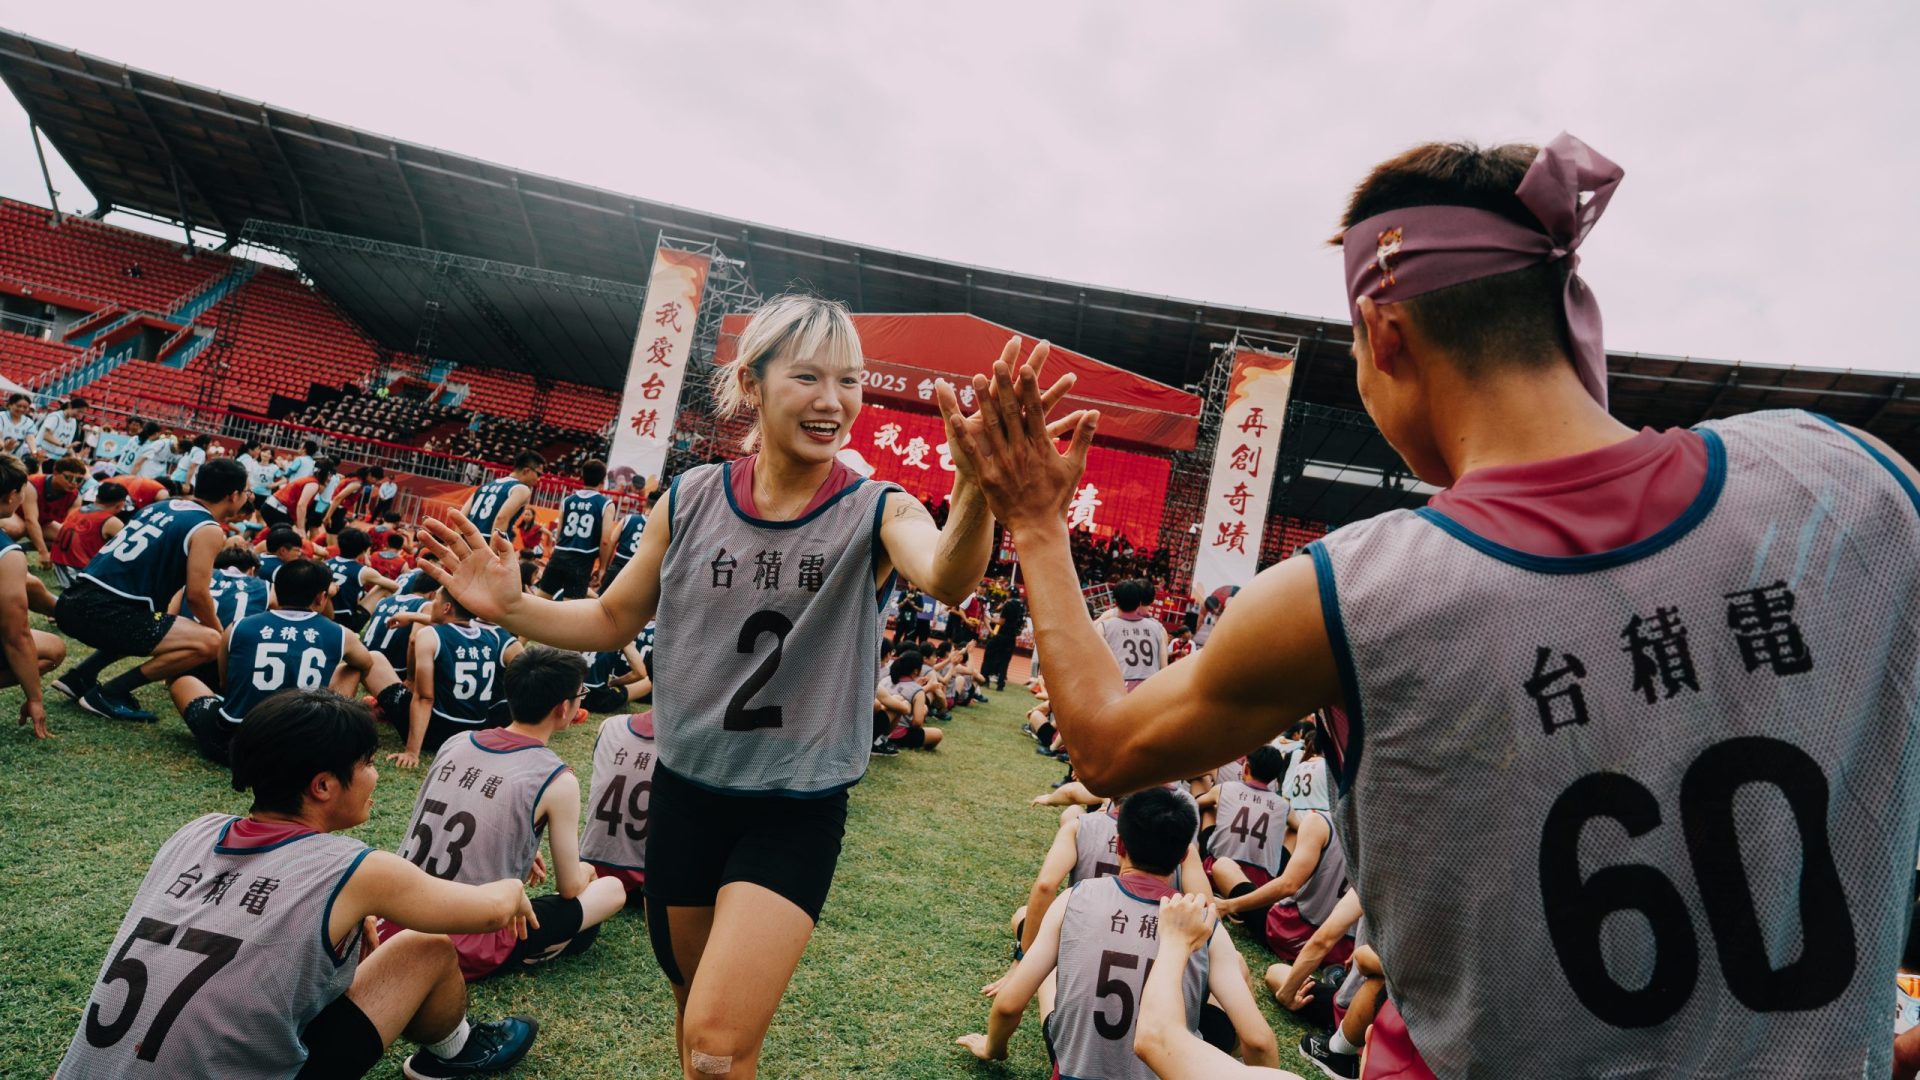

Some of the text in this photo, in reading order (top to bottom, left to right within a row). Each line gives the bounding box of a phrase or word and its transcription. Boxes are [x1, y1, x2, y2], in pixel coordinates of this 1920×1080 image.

[631, 301, 682, 438] 我愛台積
[860, 370, 976, 407] 2025 台電
[470, 493, 497, 519] 13
[1212, 407, 1268, 555] 再創奇蹟
[563, 511, 595, 539] 39
[711, 548, 824, 592] 台積電
[260, 625, 320, 643] 台積電
[1122, 638, 1154, 667] 39
[1523, 580, 1814, 735] 台積電
[252, 642, 327, 692] 56
[723, 610, 794, 731] 2
[437, 760, 504, 799] 台積電
[1292, 773, 1312, 798] 33
[595, 774, 652, 841] 49
[1230, 806, 1270, 850] 44
[403, 798, 477, 881] 53
[165, 864, 280, 916] 台積電
[1538, 735, 1858, 1030] 60
[85, 916, 244, 1063] 57
